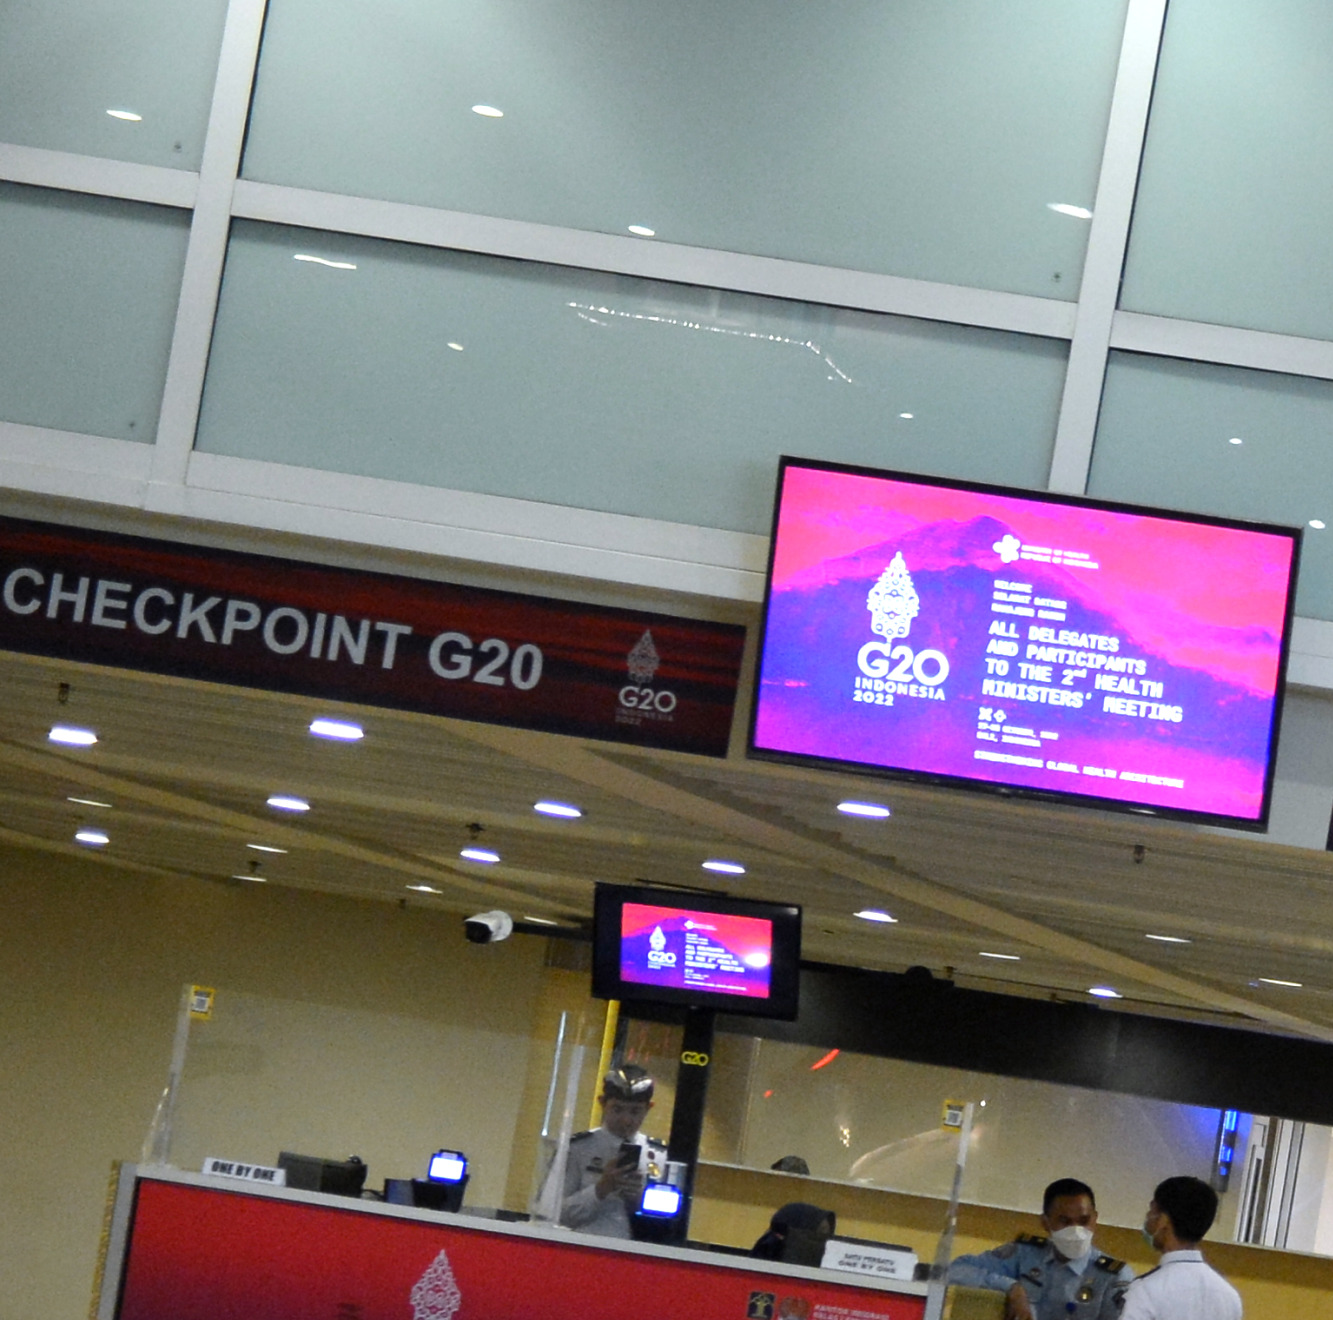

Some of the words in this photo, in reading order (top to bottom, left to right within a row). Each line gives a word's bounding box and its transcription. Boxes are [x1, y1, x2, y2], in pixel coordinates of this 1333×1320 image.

[3, 567, 412, 670] CHECKPOINT
[428, 631, 544, 690] G20
[989, 620, 1019, 638] ALL
[1028, 625, 1119, 652] DELEGATES
[857, 641, 950, 687] G20
[986, 639, 1018, 656] AND
[1026, 644, 1147, 675] PARTICIPANTS
[854, 676, 945, 701] INDONESIA
[985, 658, 1009, 676] TO
[1018, 662, 1053, 682] THE
[1061, 668, 1087, 686] 2nd
[1095, 673, 1163, 698] HEALTH
[619, 686, 676, 712] G20
[852, 690, 894, 707] 2022
[982, 678, 1092, 708] MINISTERS'
[1103, 696, 1183, 722] MEETING
[648, 951, 676, 964] G20
[681, 1051, 709, 1066] G20
[212, 1161, 233, 1175] ONE
[236, 1164, 253, 1177] BY
[254, 1167, 276, 1181] ONE
